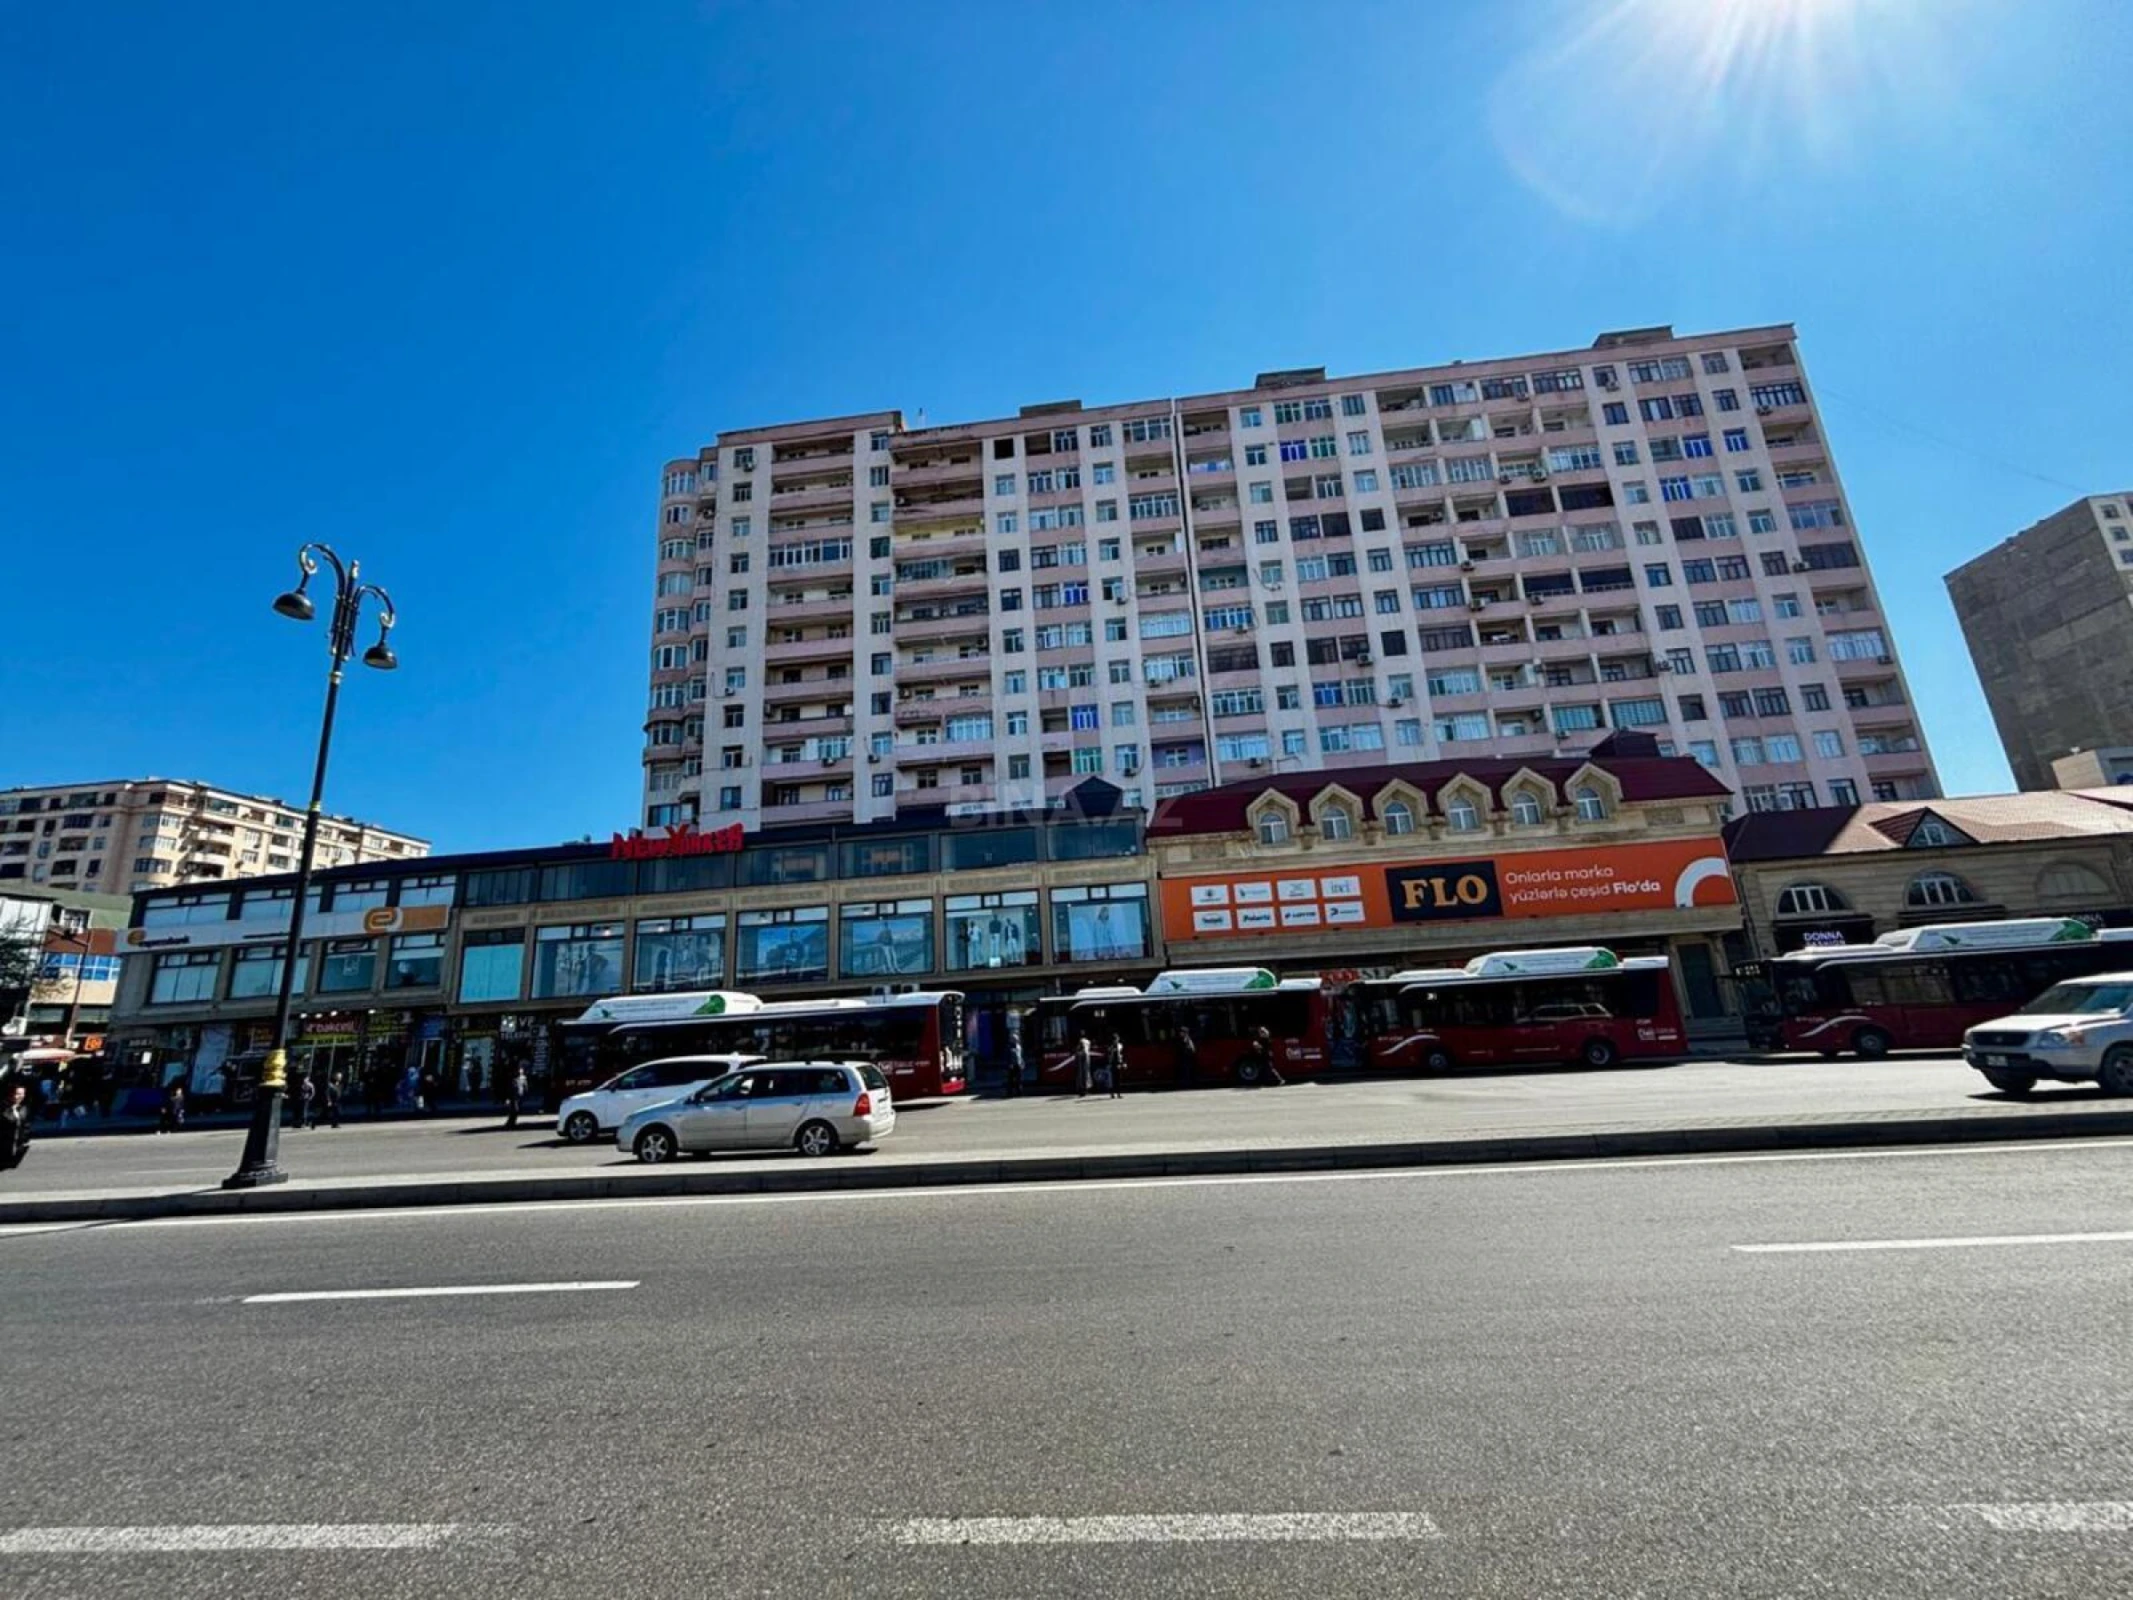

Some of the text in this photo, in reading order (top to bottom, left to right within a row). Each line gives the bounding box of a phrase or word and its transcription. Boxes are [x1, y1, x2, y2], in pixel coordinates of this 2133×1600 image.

[1505, 864, 1614, 884] Onlarla marka
[1400, 874, 1489, 909] FLO
[1612, 879, 1662, 895] Flo'da
[1803, 930, 1844, 941] DONNA
